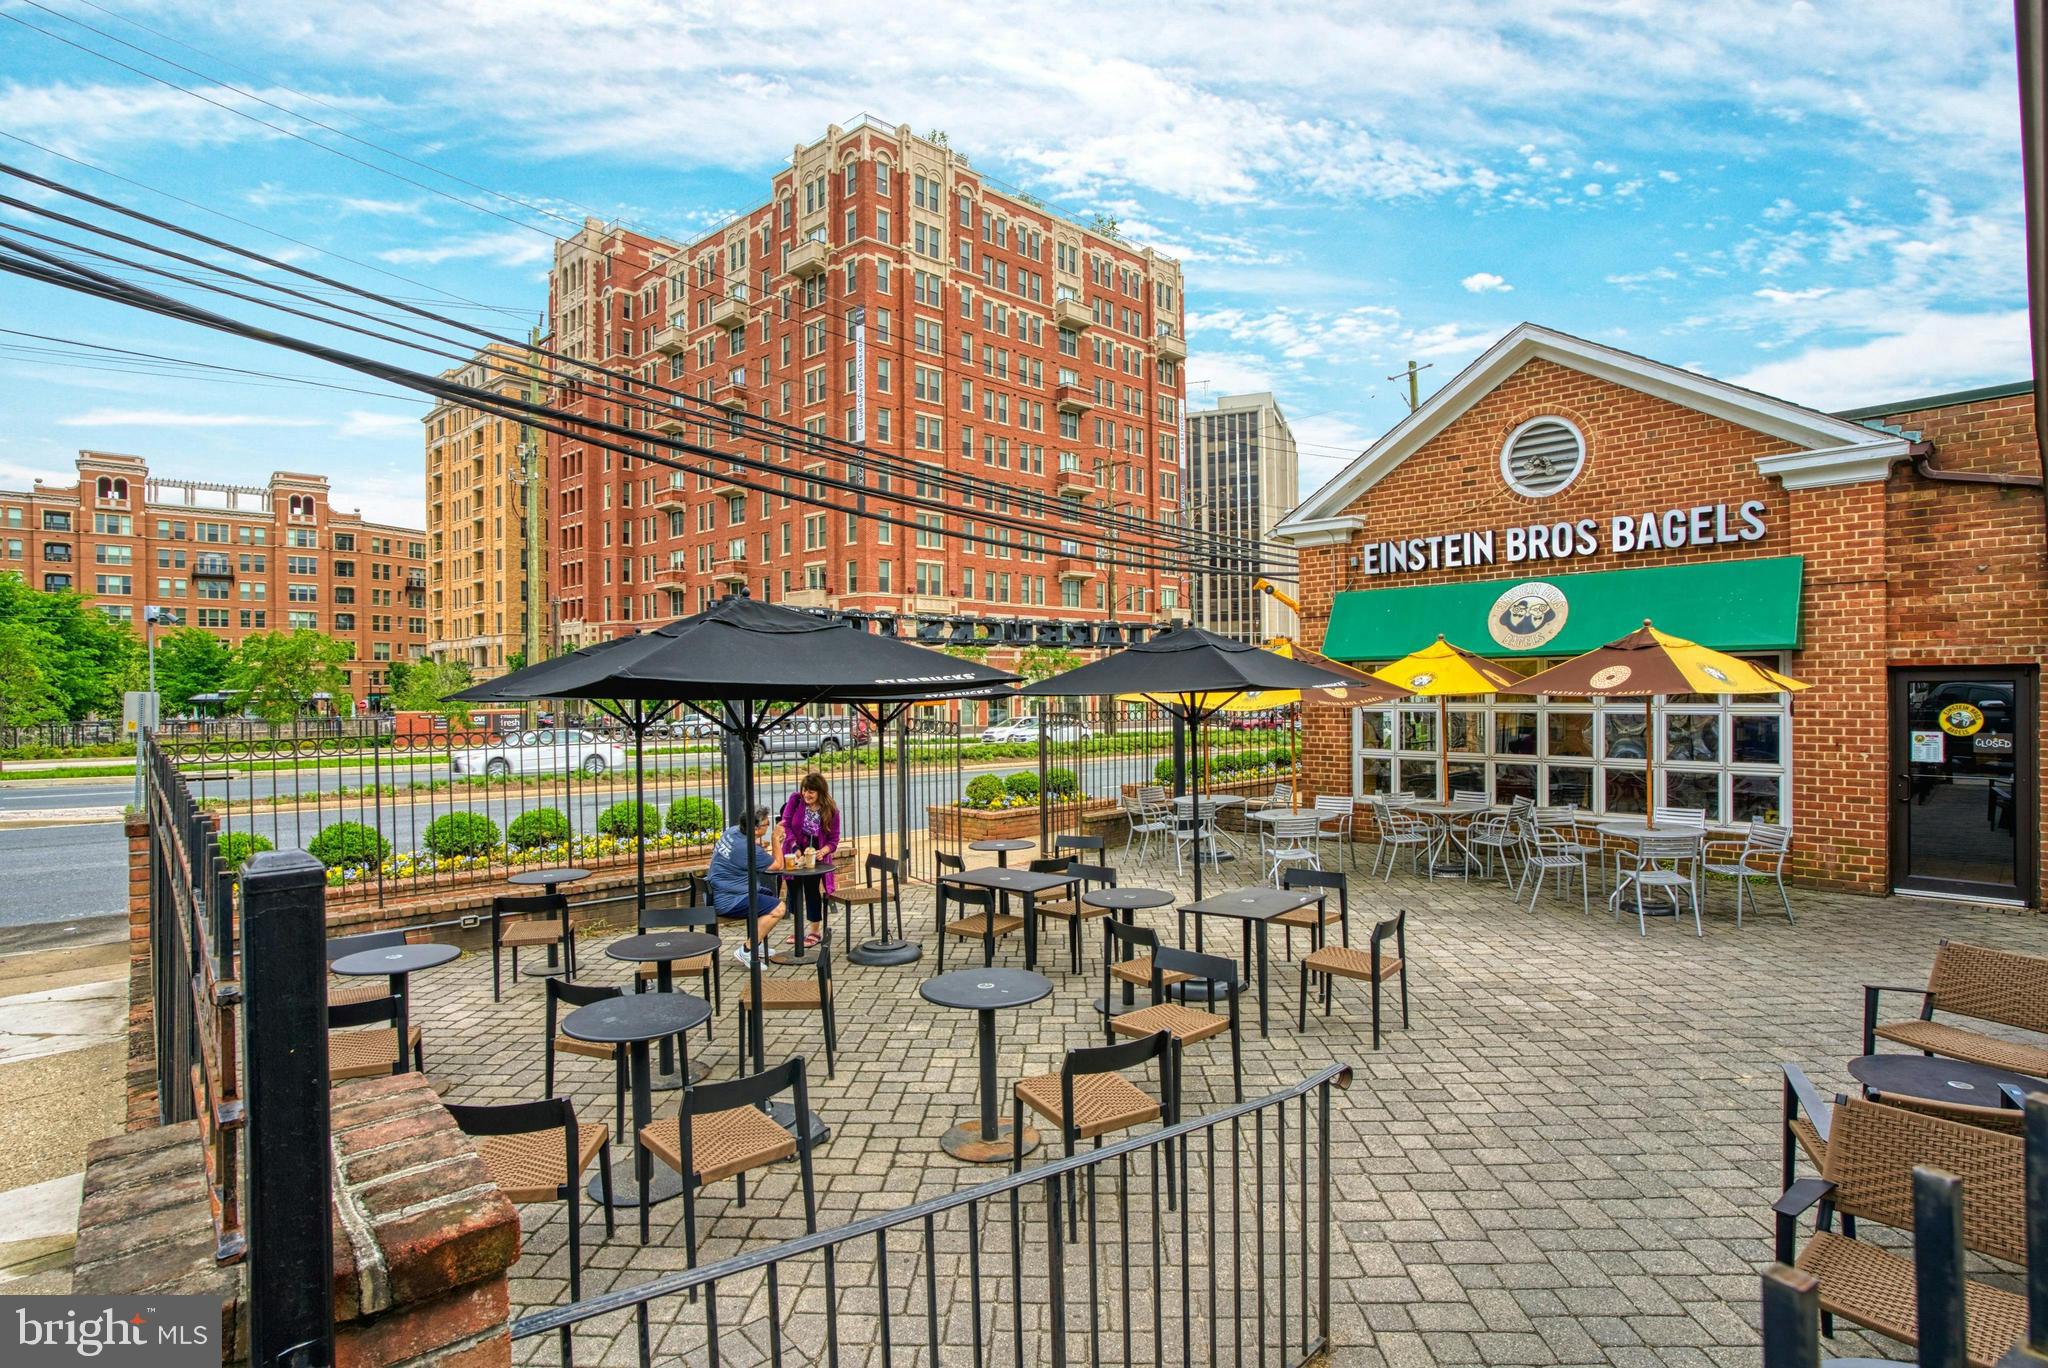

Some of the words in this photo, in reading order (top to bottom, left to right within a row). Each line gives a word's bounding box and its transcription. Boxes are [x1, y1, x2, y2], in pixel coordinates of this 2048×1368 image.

[1364, 530, 1496, 575] EINSTEIN
[1506, 518, 1599, 562] BROS
[1612, 500, 1768, 553] BAGELS
[1495, 583, 1541, 612] EINSTEIN
[1502, 631, 1546, 647] BAGELS
[874, 672, 976, 684] STARBUCKS
[924, 688, 993, 698] STARBUCKS
[1943, 703, 1969, 716] EINSTEIN
[1946, 726, 1969, 736] BAGELS
[1975, 738, 2012, 748] CLOSED
